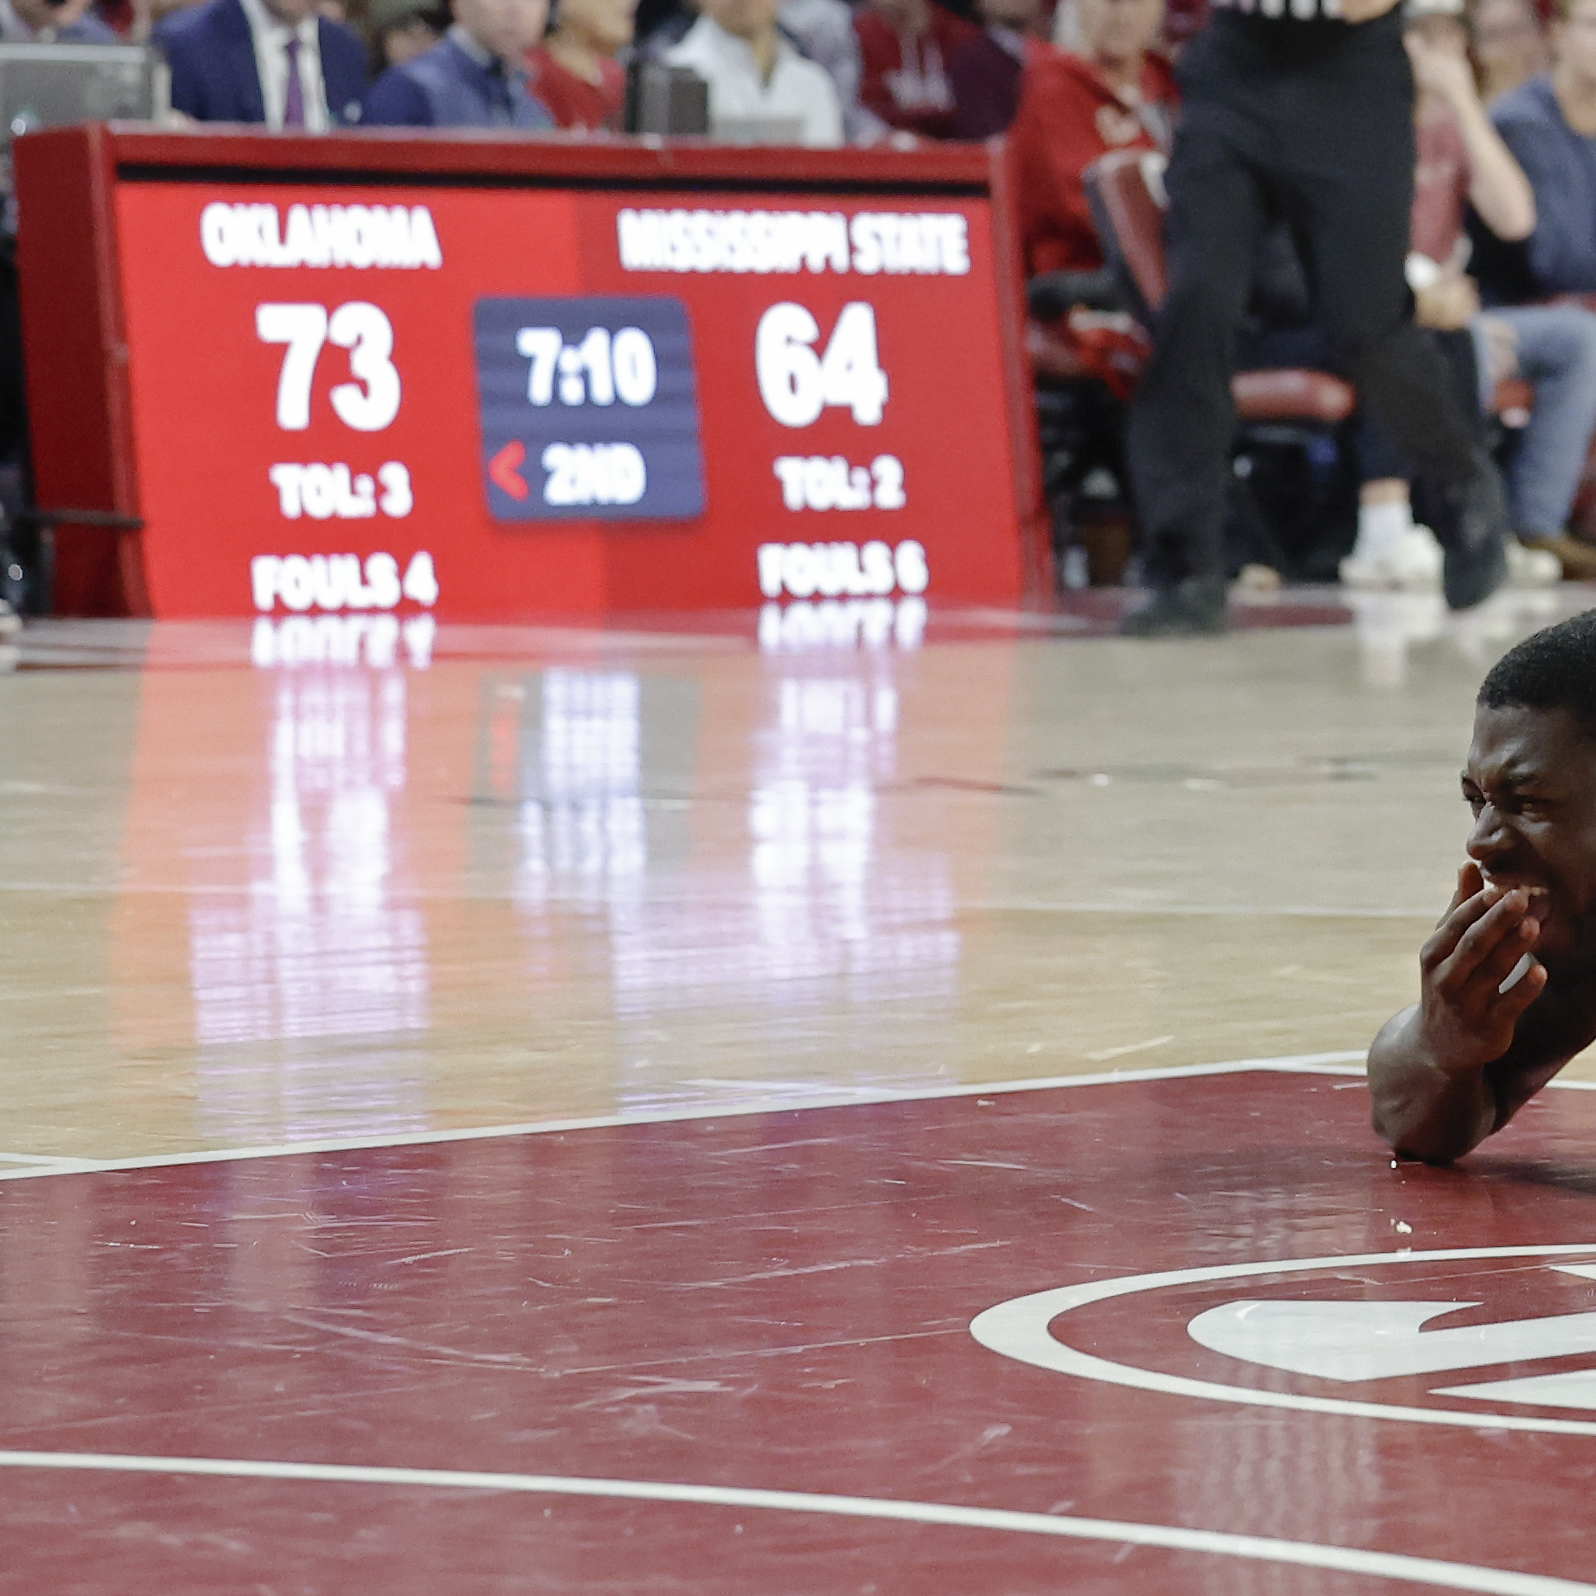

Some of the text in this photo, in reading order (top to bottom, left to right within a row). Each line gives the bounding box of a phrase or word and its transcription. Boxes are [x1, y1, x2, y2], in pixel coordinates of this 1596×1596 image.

[201, 202, 443, 270] OKLAHOMA
[617, 207, 971, 276] MISSISSIPPI STATE
[255, 301, 402, 431] 73
[516, 326, 658, 407] 7:10
[755, 301, 889, 428] 64
[269, 460, 414, 519] TOL: 3
[541, 441, 647, 506] 2ND
[773, 454, 907, 511] TOL: 2
[251, 549, 440, 612] FOULS 4
[757, 539, 894, 599] FOULS
